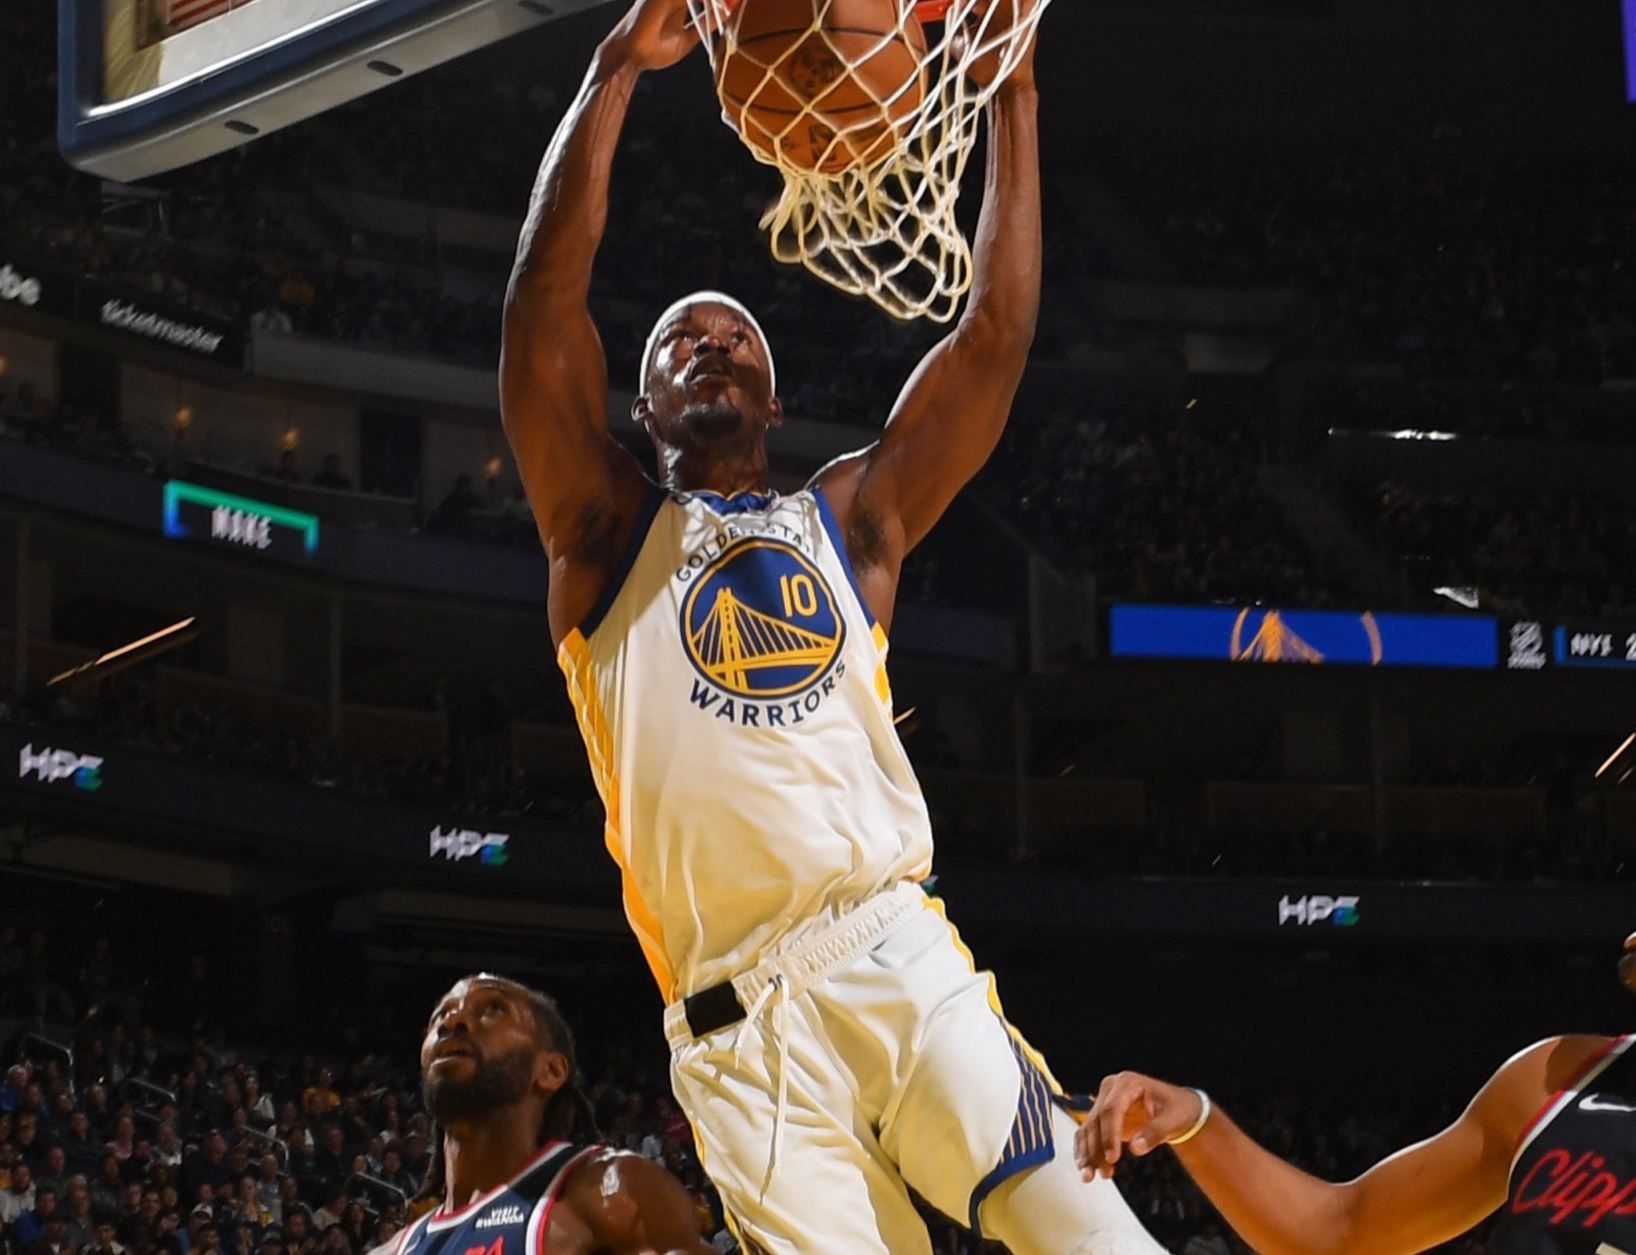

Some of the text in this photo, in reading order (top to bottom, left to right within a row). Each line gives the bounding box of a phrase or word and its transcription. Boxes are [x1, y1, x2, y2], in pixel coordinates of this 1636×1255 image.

[779, 574, 818, 618] 10
[689, 659, 847, 728] WARRIORS
[19, 742, 105, 792] HPE
[429, 823, 510, 867] HPE
[1278, 894, 1361, 928] HPE
